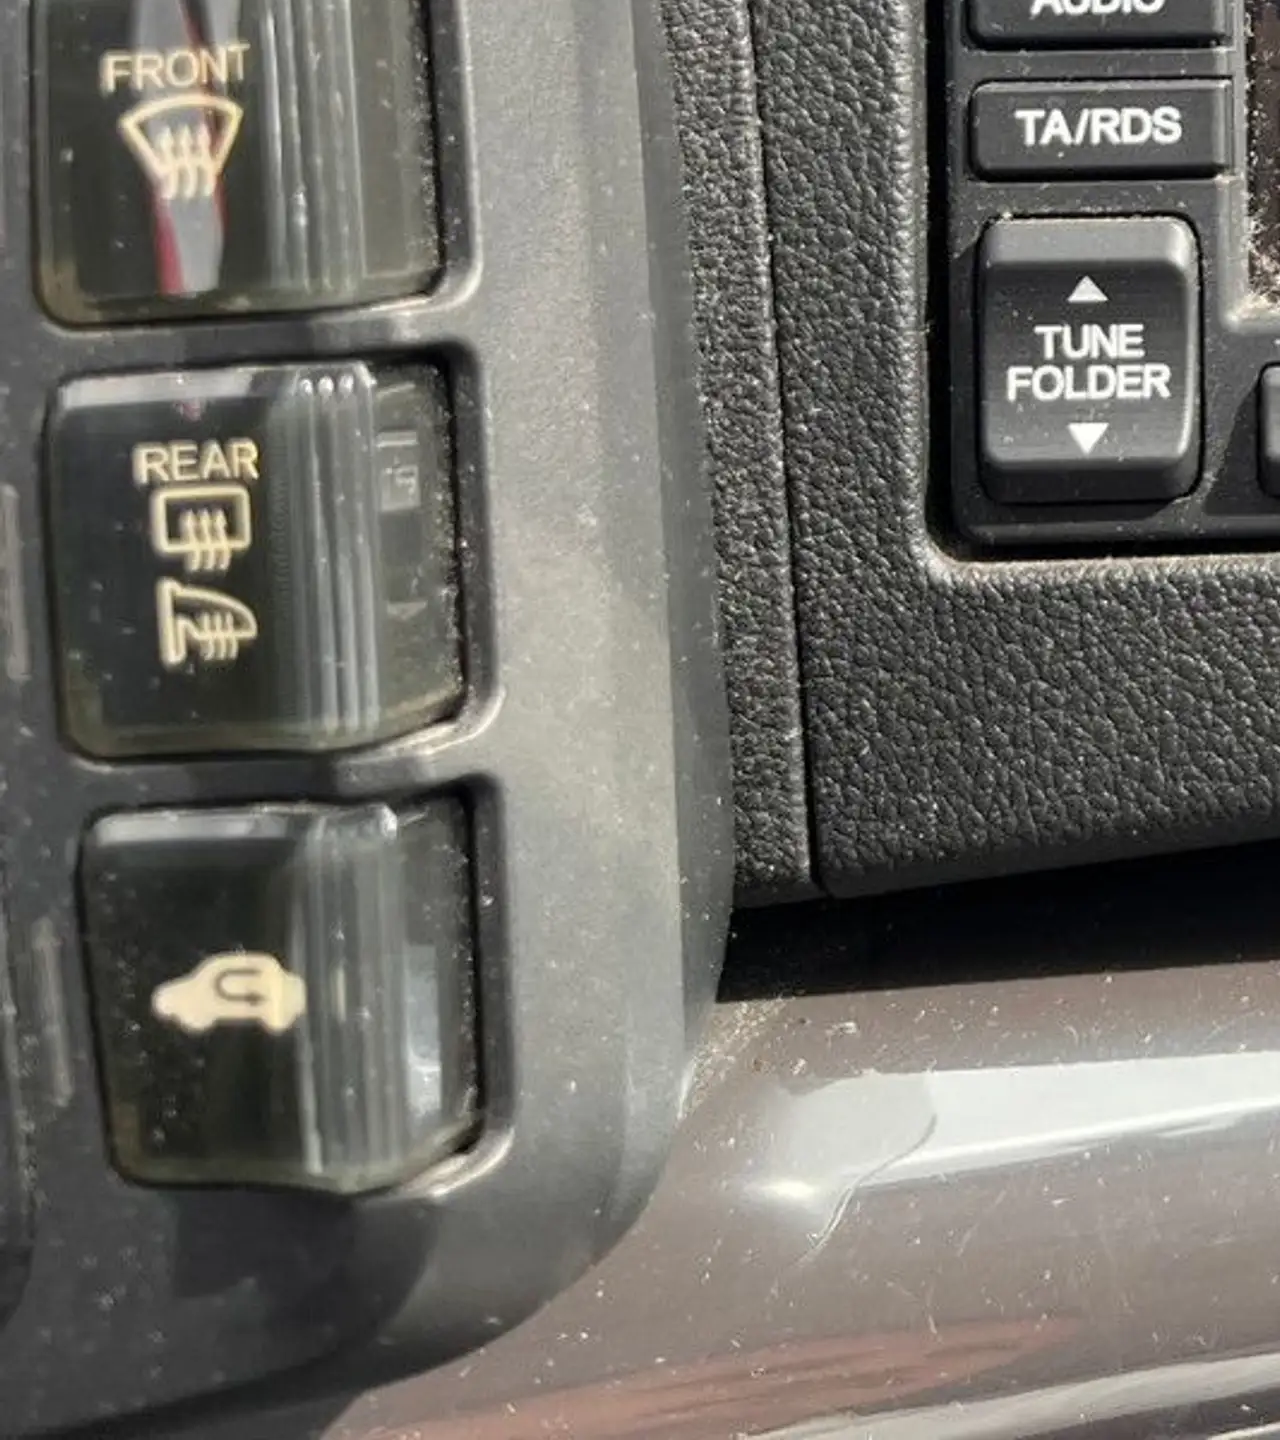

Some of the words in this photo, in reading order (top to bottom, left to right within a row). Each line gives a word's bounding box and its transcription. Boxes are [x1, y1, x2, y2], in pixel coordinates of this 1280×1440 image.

[102, 42, 251, 95] FRONT
[1015, 106, 1182, 145] TA/RDS
[1035, 323, 1145, 359] TUNE
[1008, 364, 1171, 401] FOLDER
[133, 438, 259, 485] REAR
